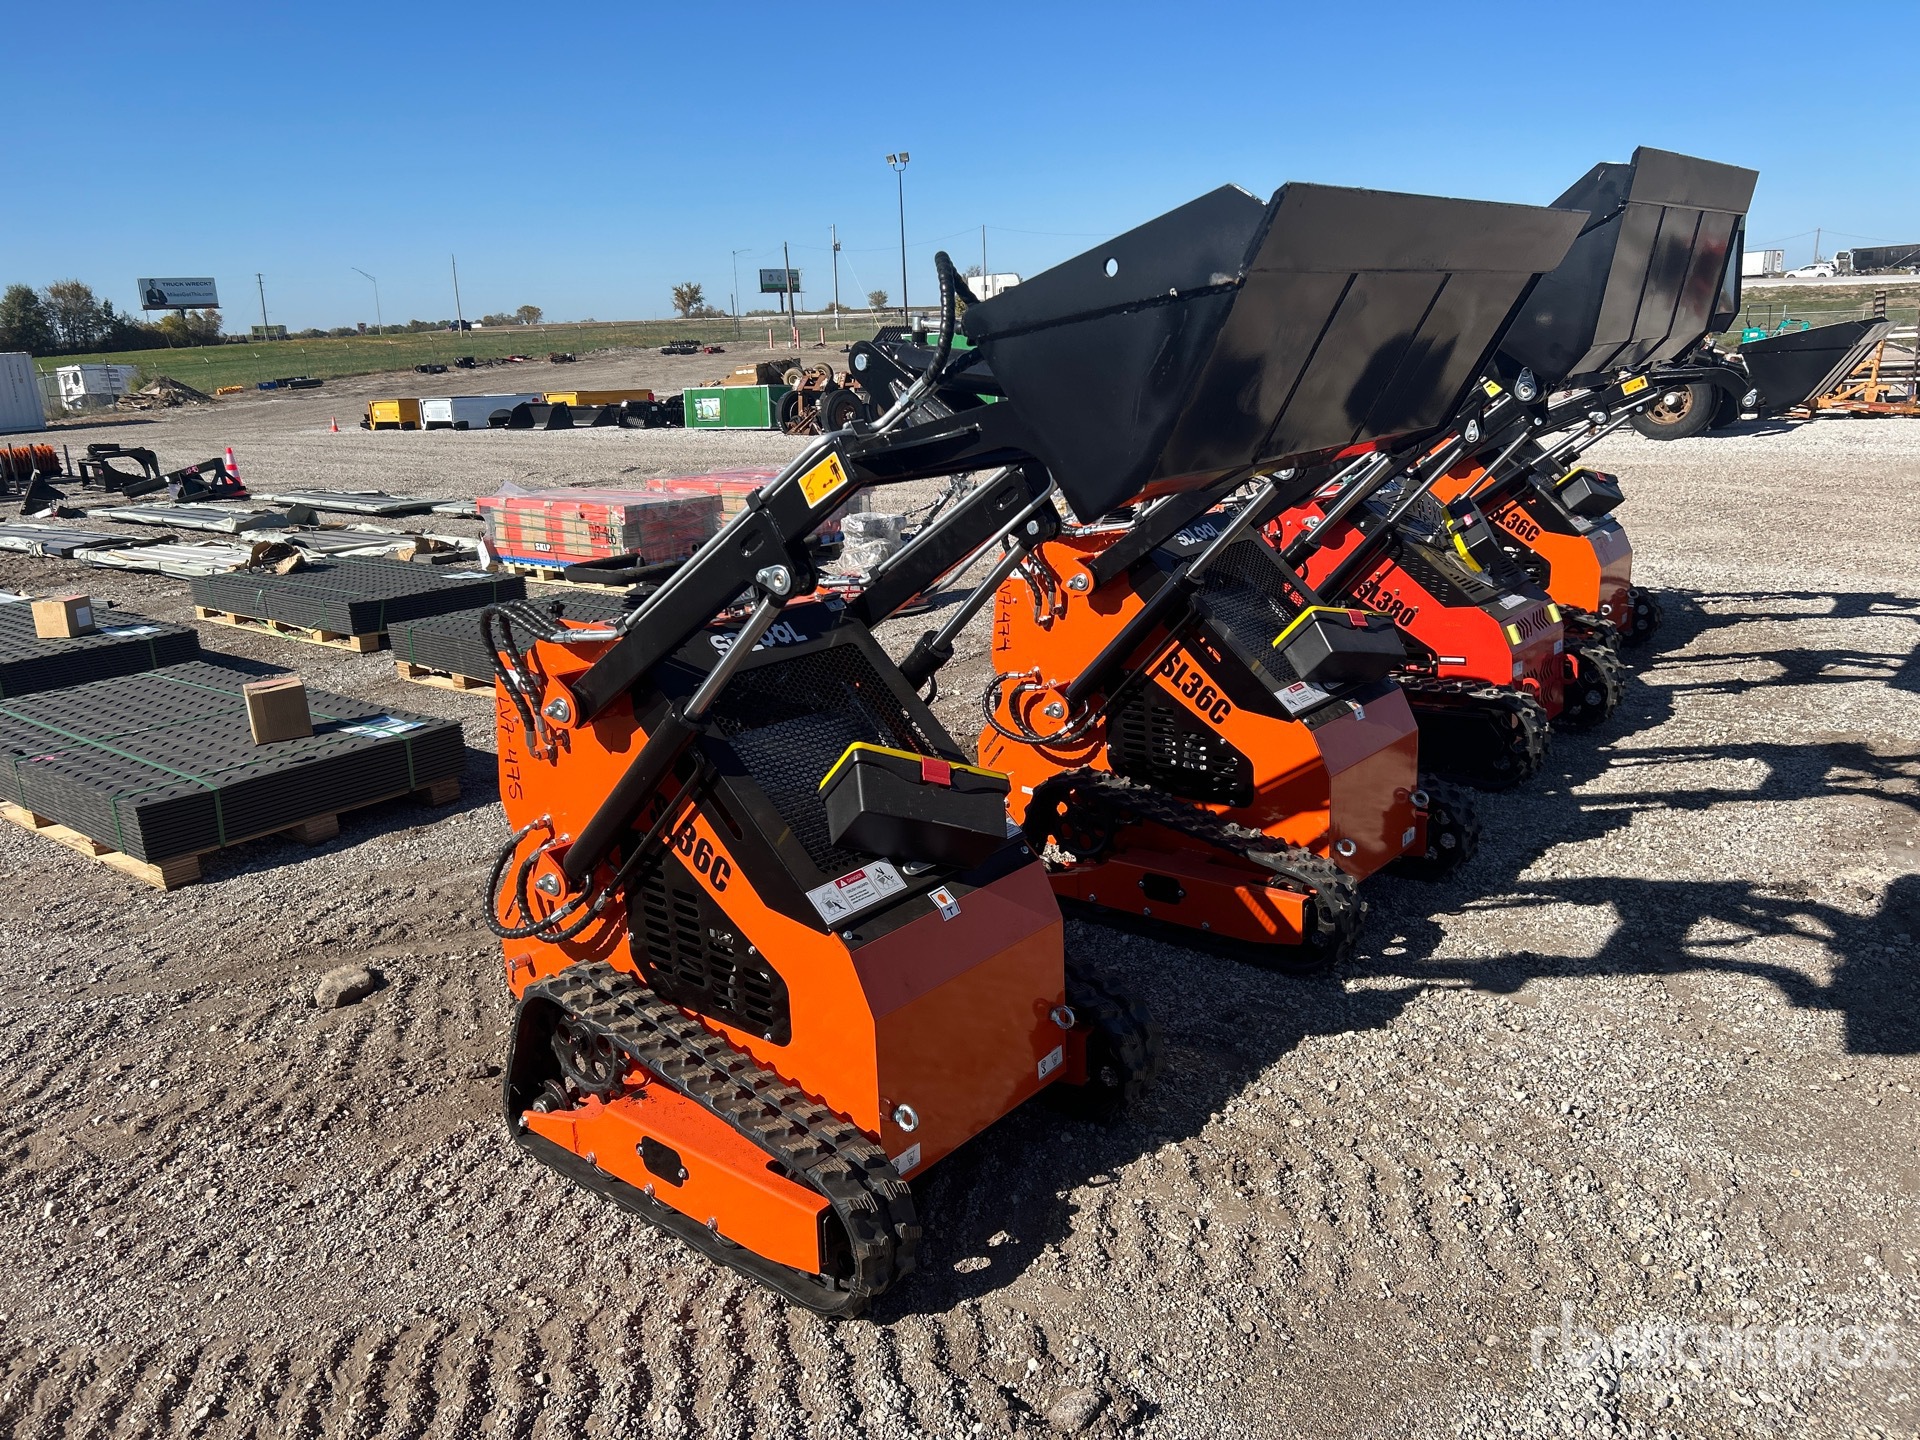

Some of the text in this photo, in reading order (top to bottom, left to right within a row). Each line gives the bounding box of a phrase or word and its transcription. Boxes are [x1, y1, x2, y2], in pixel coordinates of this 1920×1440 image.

[996, 579, 1012, 651] V7-474
[1357, 579, 1416, 627] SL380
[1160, 652, 1231, 724] SL36C
